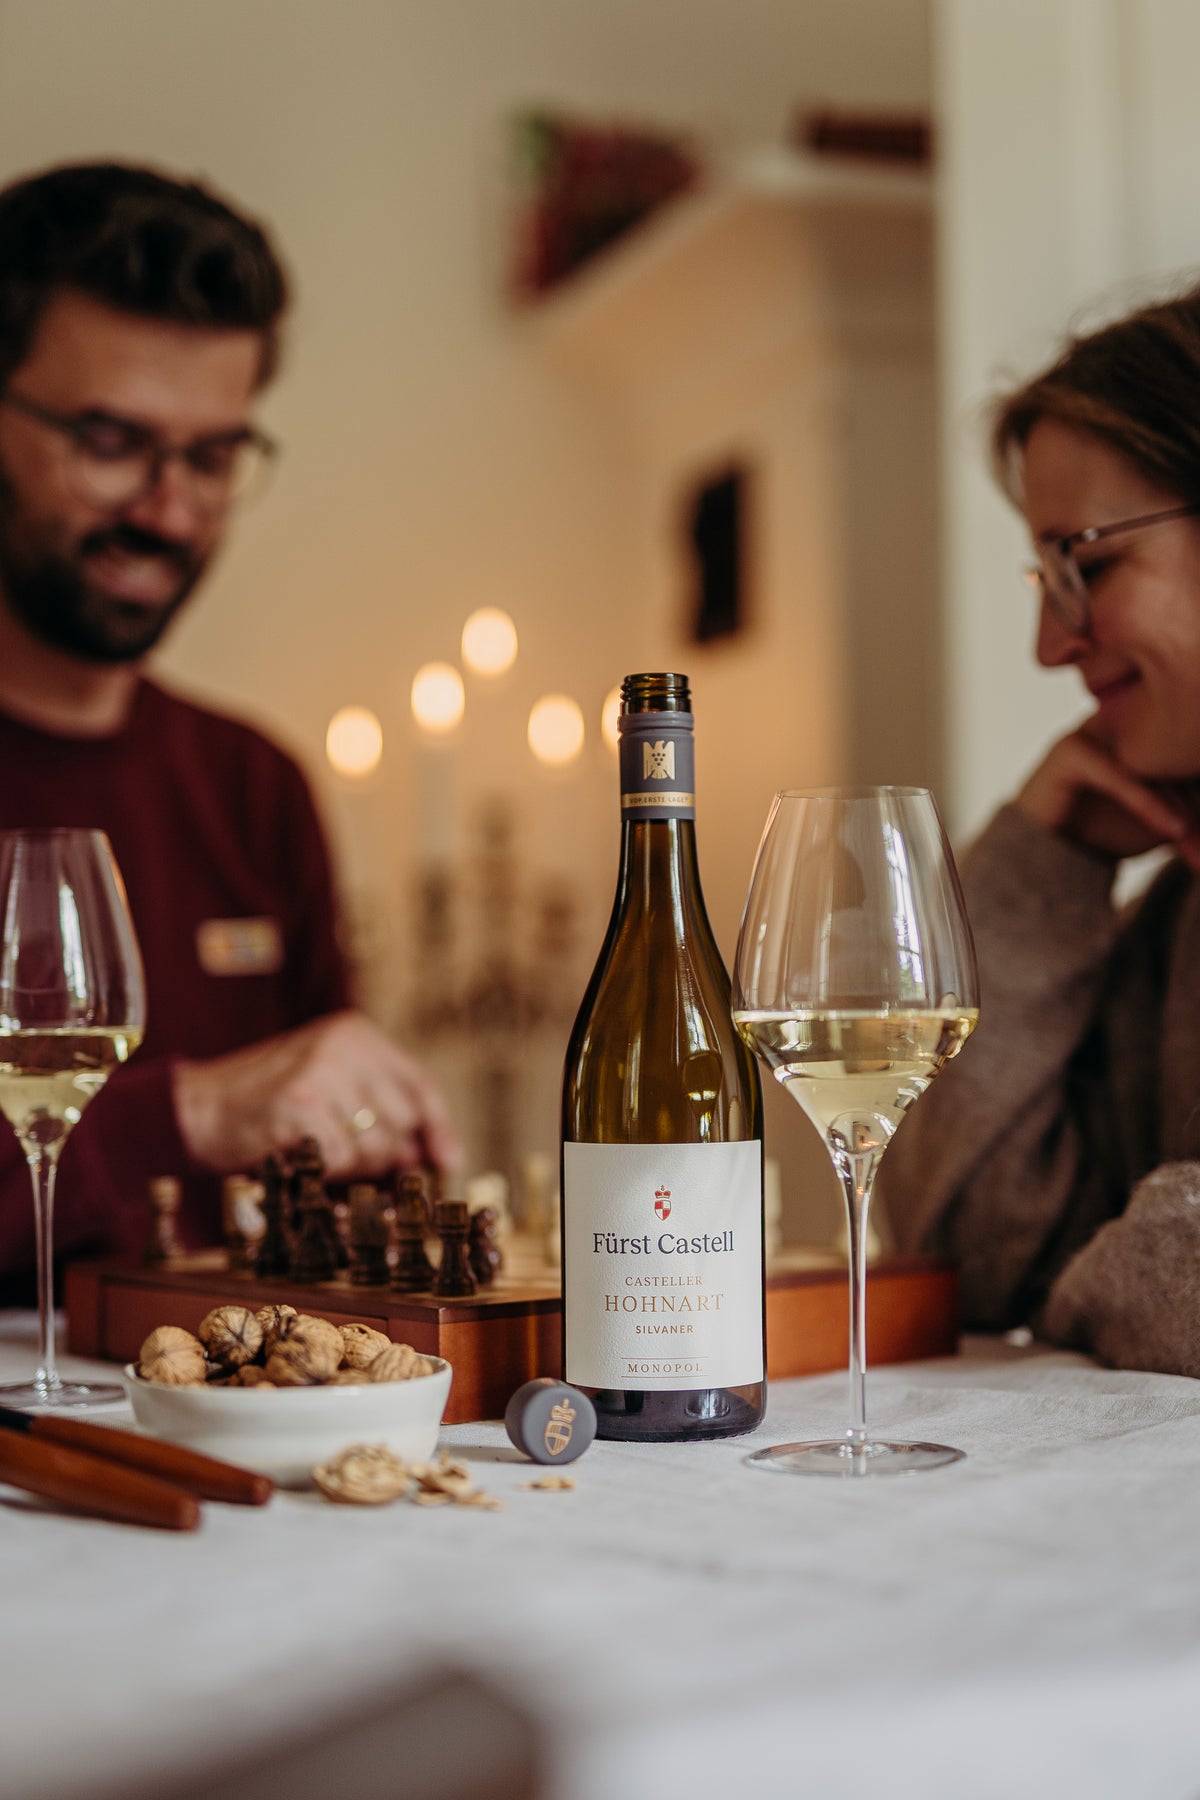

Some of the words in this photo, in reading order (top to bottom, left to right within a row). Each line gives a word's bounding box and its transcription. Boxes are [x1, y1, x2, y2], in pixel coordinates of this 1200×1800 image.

[592, 1232, 652, 1255] Fürst
[657, 1230, 735, 1255] Castell
[625, 1275, 703, 1287] CASTELLER
[604, 1293, 724, 1313] HOHNART
[635, 1324, 694, 1335] SILVANER
[627, 1362, 703, 1373] MONOPOL
